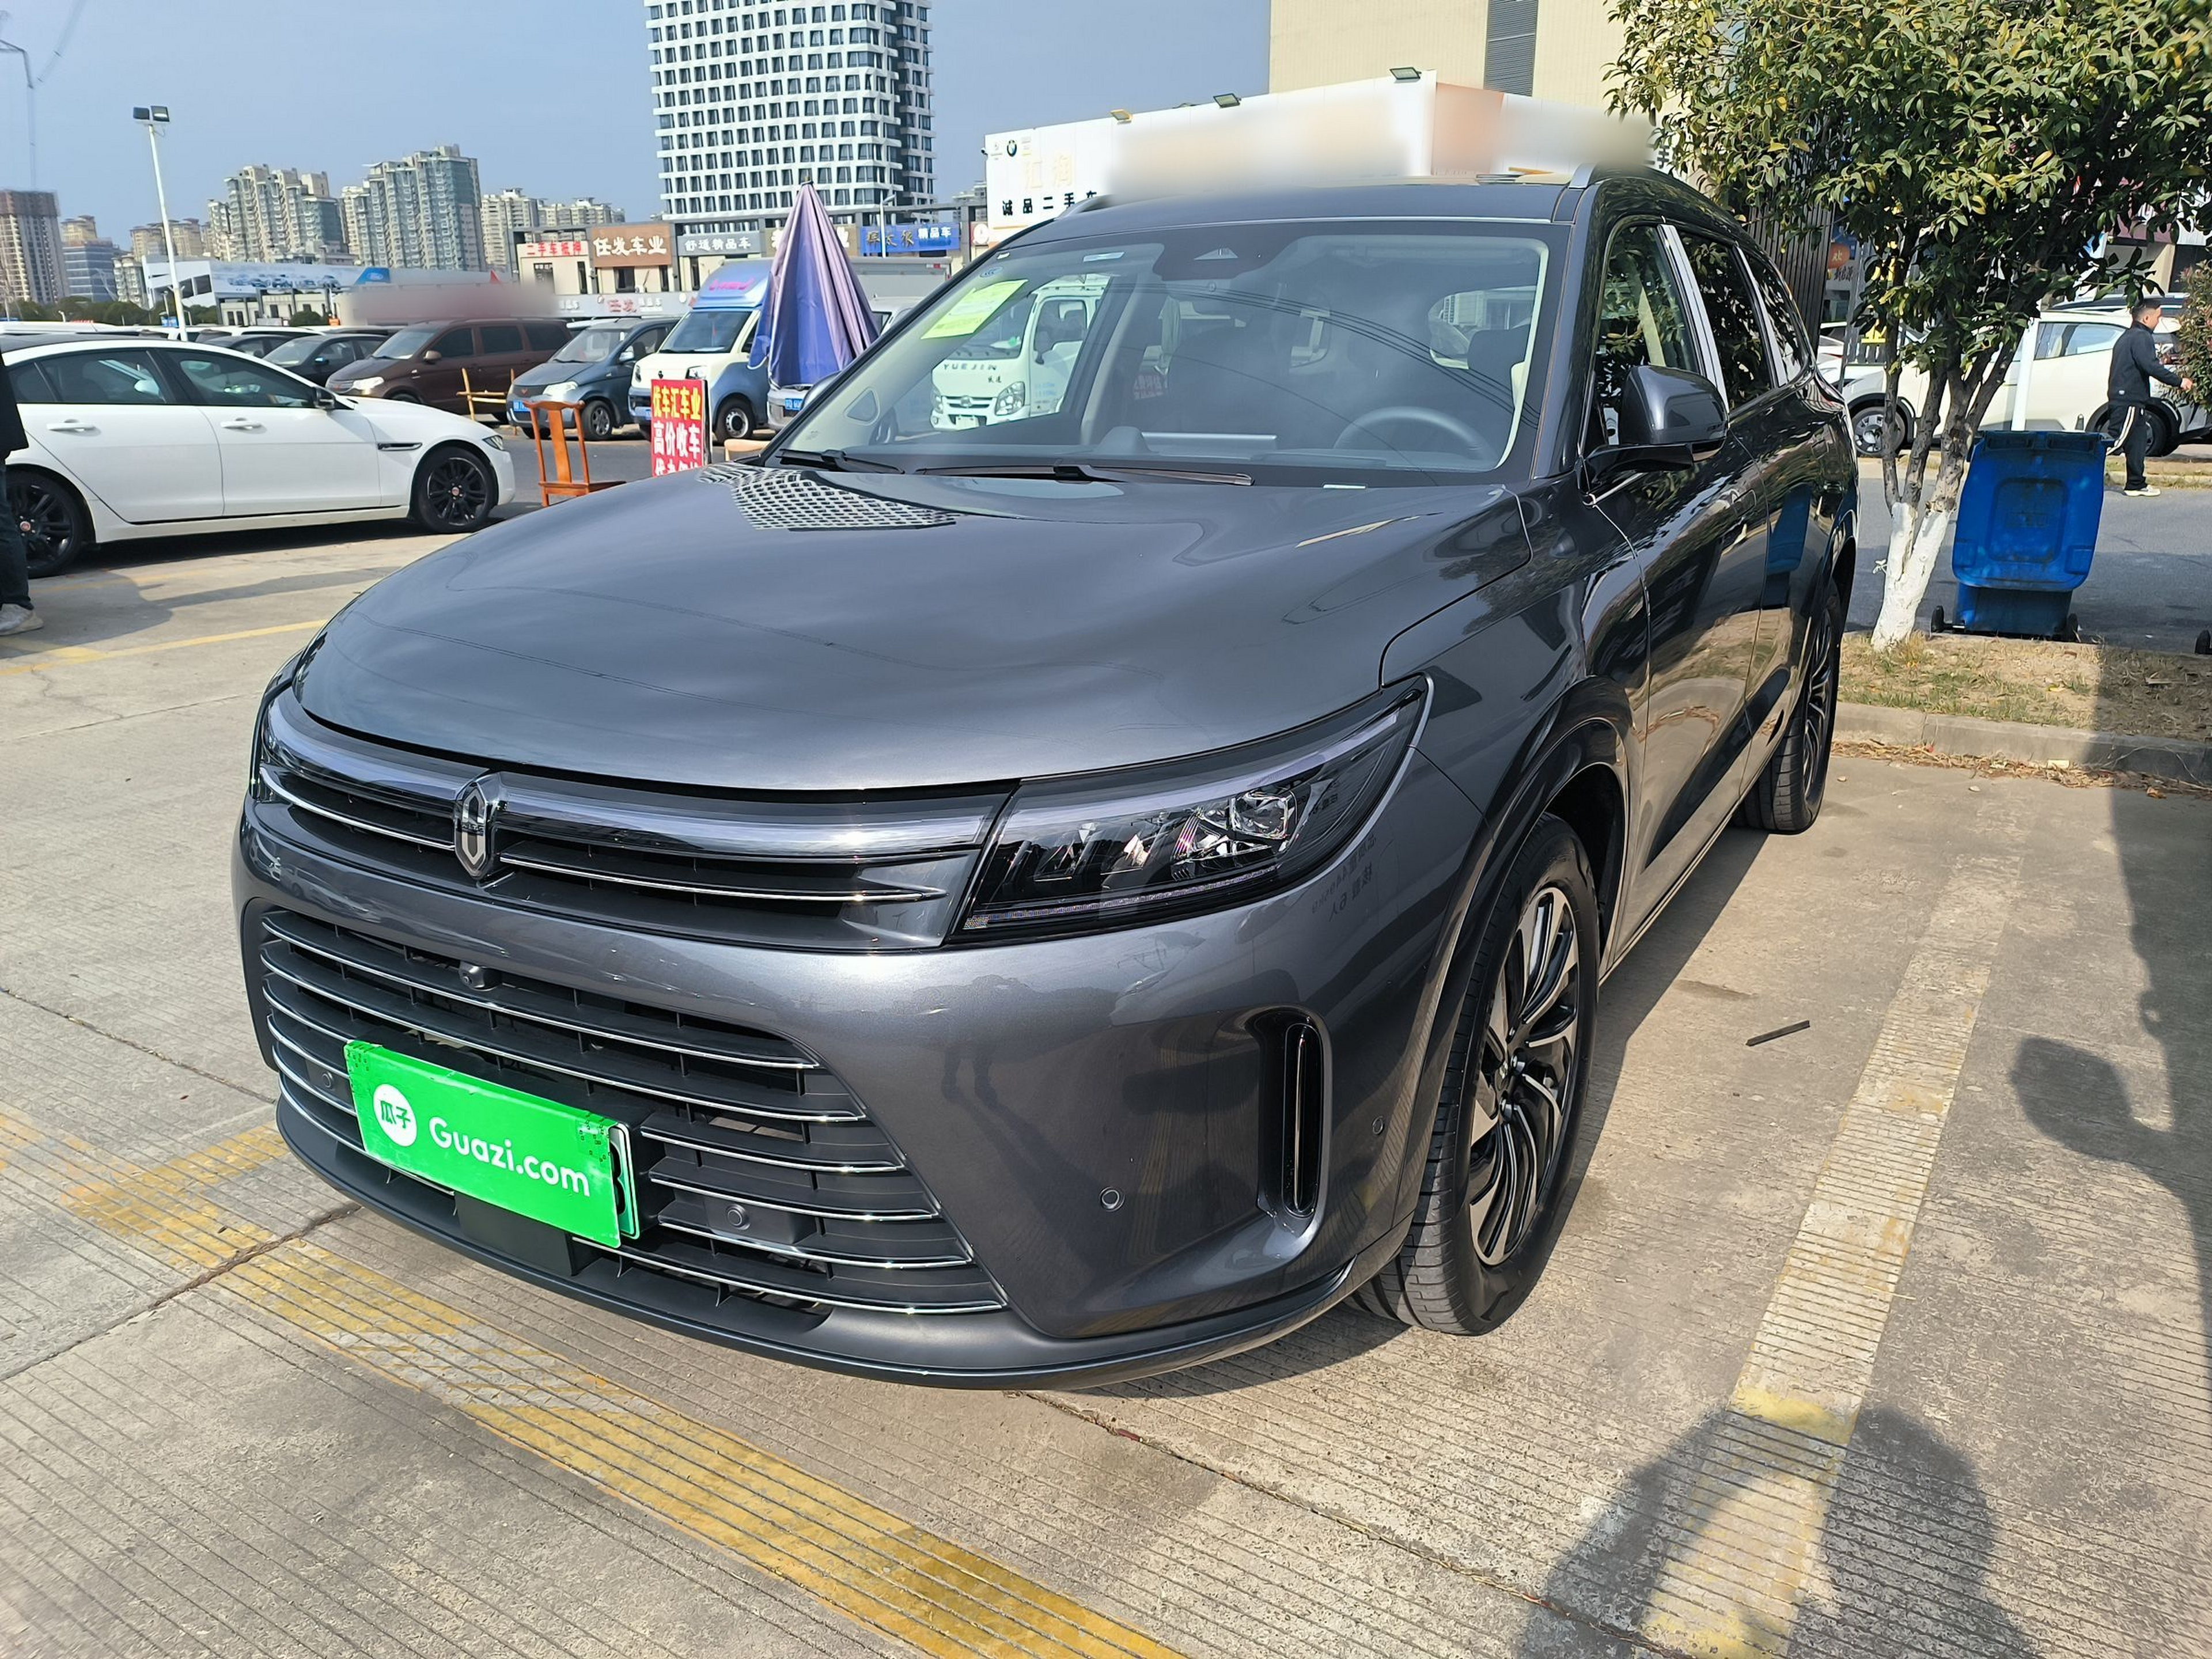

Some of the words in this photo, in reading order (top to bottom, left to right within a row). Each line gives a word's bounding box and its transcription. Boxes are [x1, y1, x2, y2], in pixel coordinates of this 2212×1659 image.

[593, 234, 667, 257] 任发车业
[653, 385, 702, 421] 优车汇车业
[653, 421, 701, 459] 高价收车
[380, 1099, 411, 1129] 瓜子
[429, 1116, 591, 1198] Guazi.com
